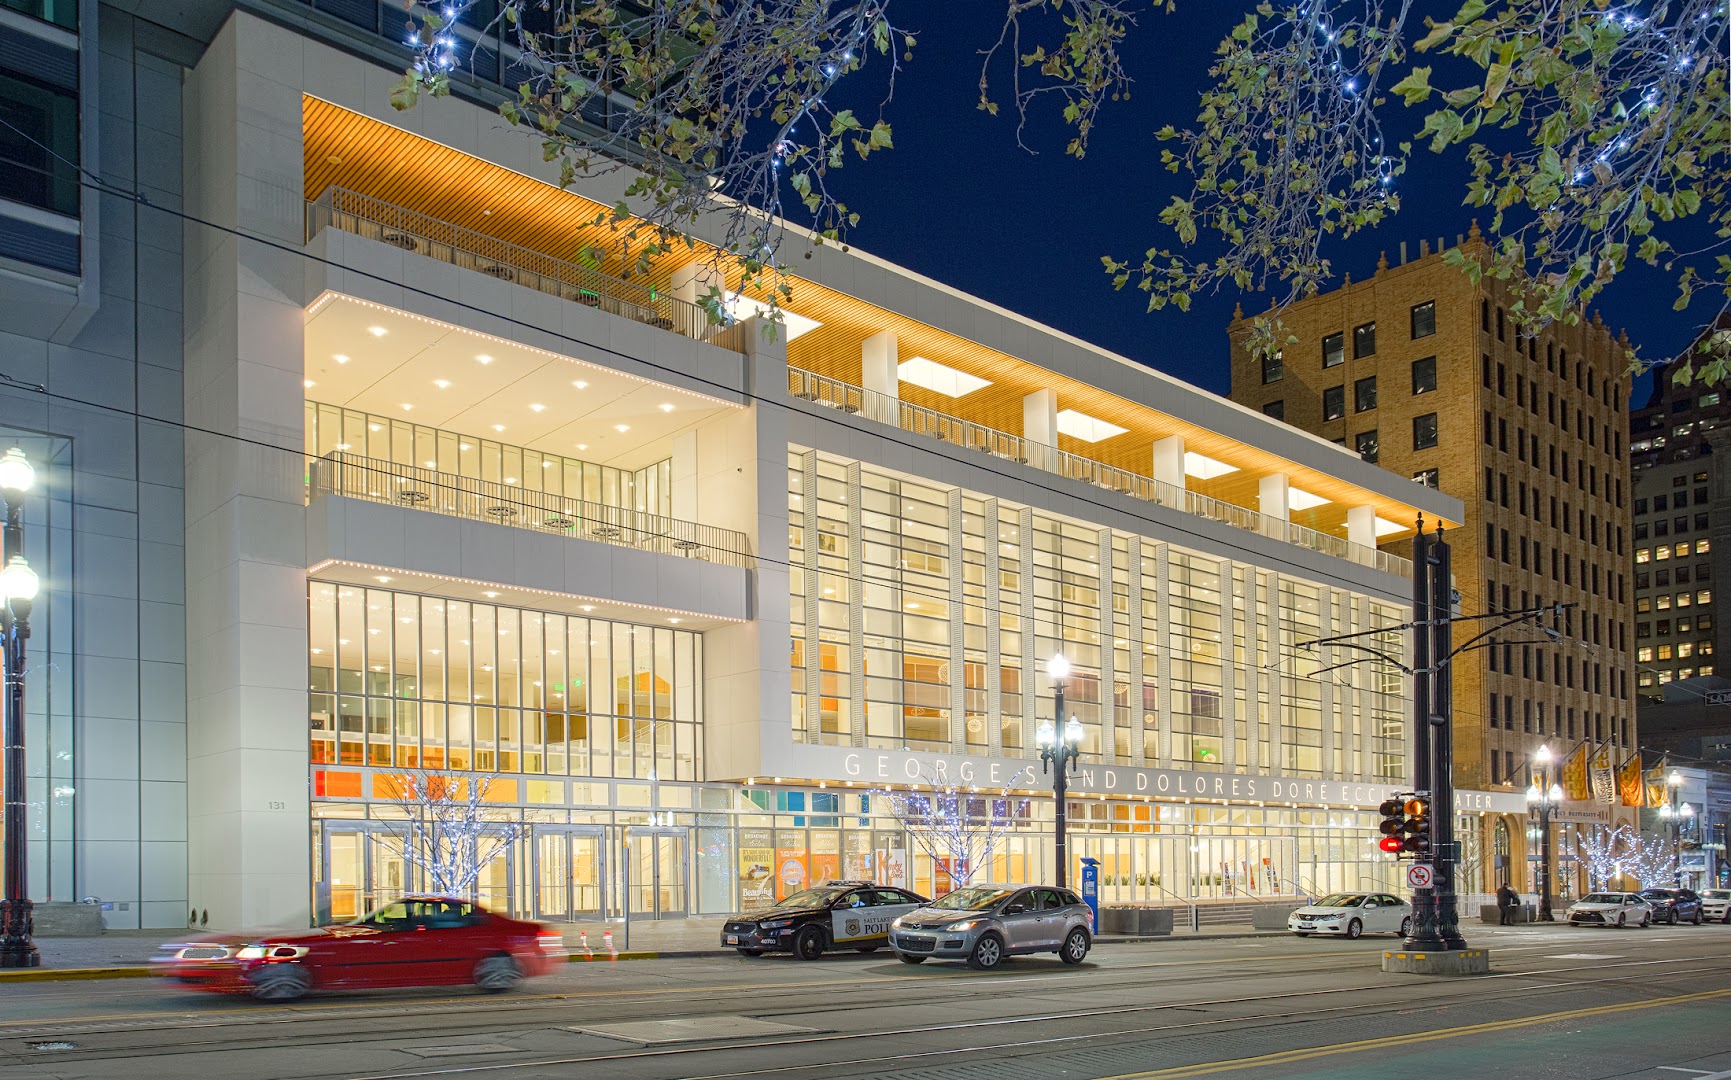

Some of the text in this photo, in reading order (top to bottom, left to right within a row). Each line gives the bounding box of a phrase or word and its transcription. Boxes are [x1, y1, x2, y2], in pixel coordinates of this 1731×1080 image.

[845, 753, 1001, 783] GEORGE
[1025, 765, 1039, 785] S.
[1137, 772, 1256, 797] DOLORES
[1274, 780, 1328, 800] DORÉ
[268, 801, 285, 810] 131
[1086, 871, 1093, 879] P
[742, 887, 773, 897] Beautiful
[864, 923, 889, 935] POLI
